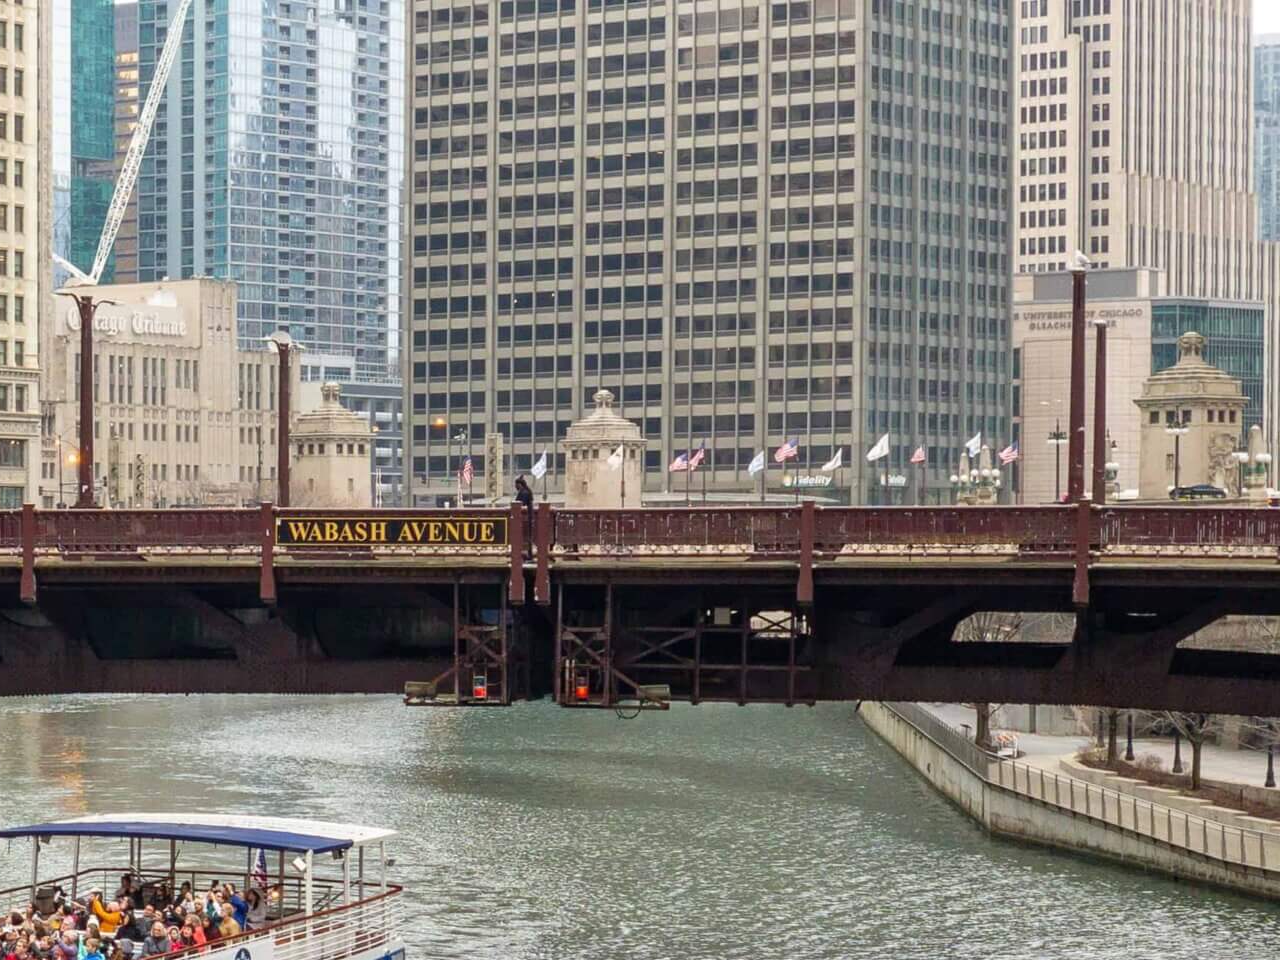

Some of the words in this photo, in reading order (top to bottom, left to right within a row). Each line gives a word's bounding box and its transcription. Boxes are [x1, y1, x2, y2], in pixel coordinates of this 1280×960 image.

[131, 311, 187, 337] Tribune
[1023, 311, 1073, 320] UNIVERSIT
[1099, 308, 1143, 318] CHICAGO
[288, 521, 386, 542] WABASH
[398, 521, 496, 542] AVENUE
